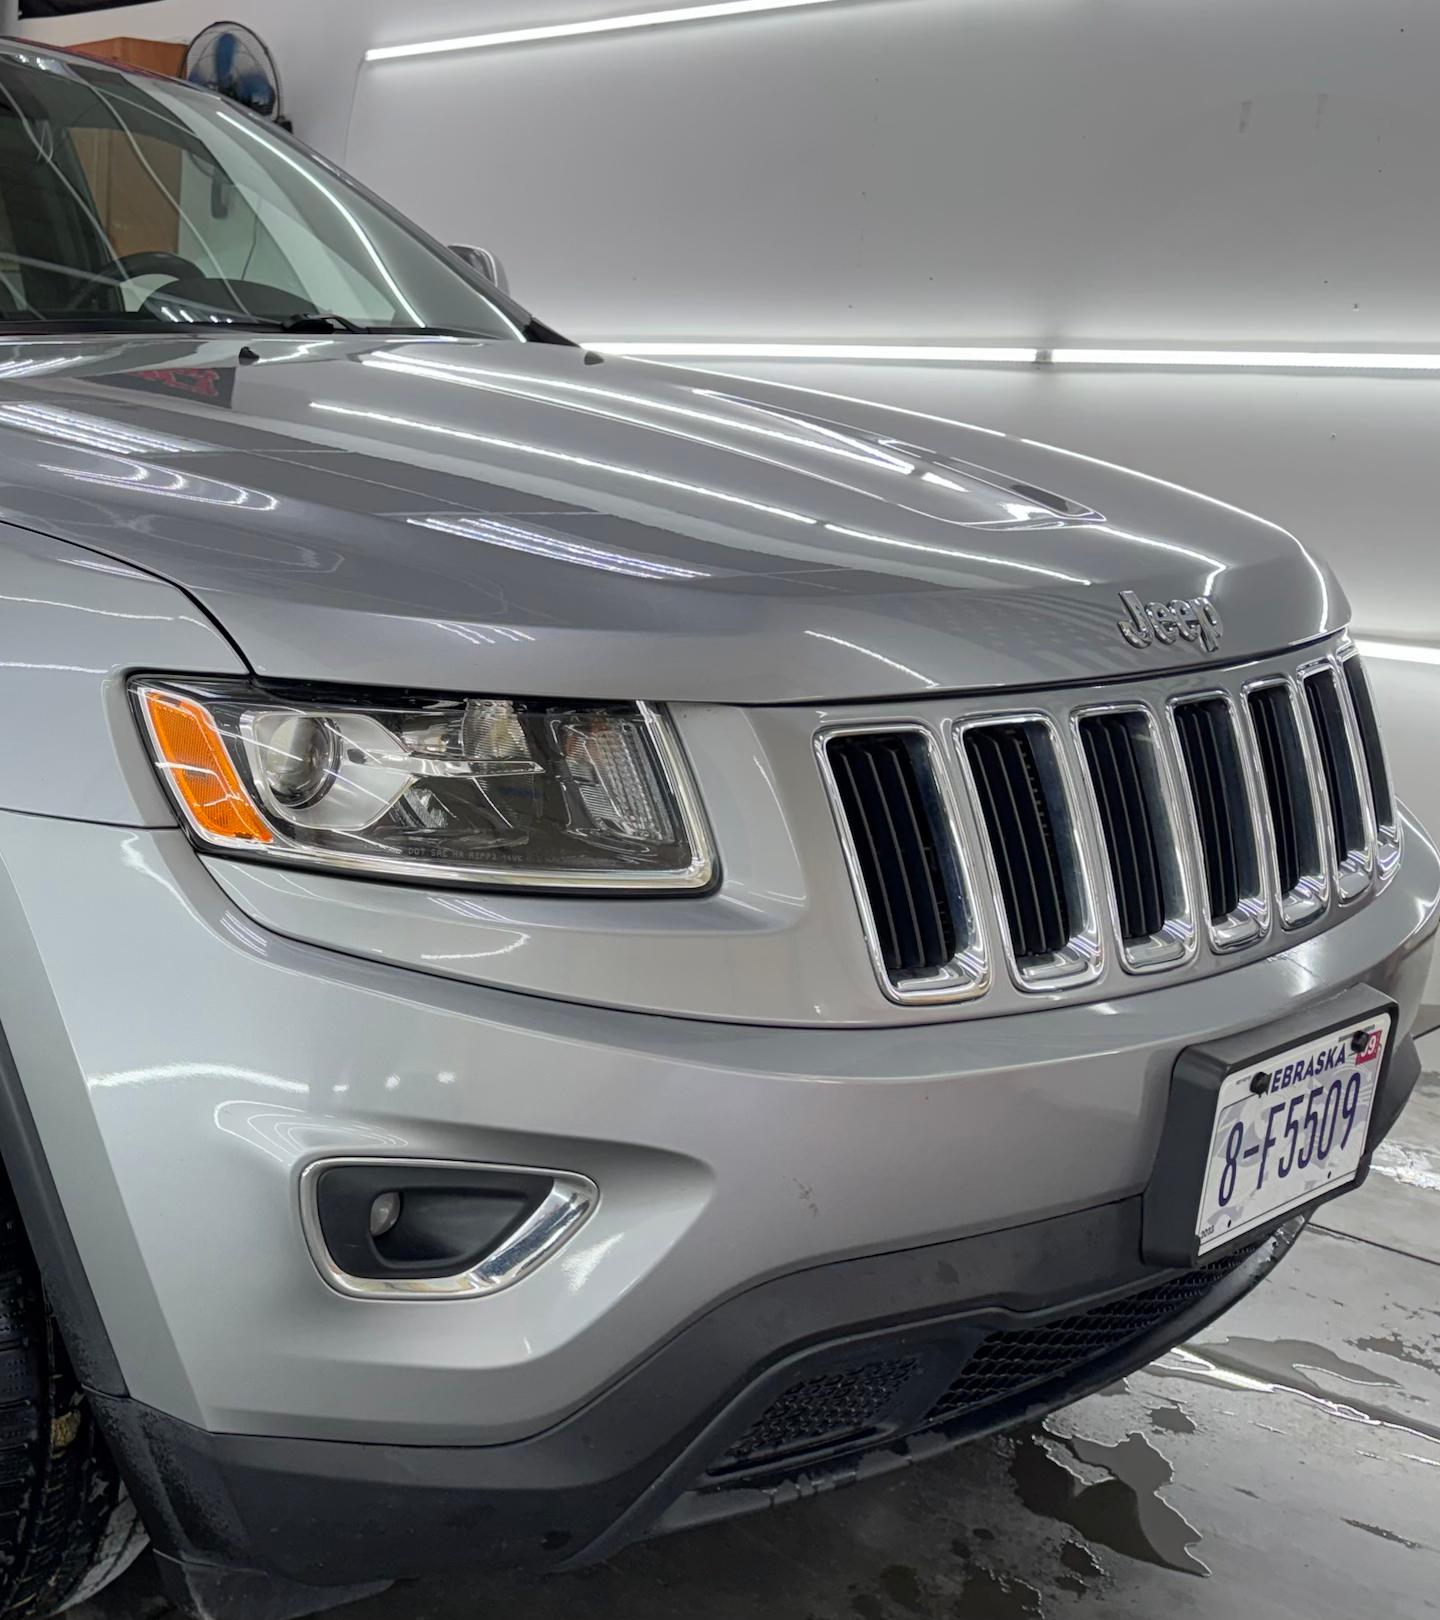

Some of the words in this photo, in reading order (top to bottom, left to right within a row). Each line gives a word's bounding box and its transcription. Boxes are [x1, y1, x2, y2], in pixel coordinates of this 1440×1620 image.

[1117, 590, 1223, 652] Jeep
[1266, 1042, 1347, 1095] EBRASKA
[1218, 1072, 1362, 1208] 8-F5509
